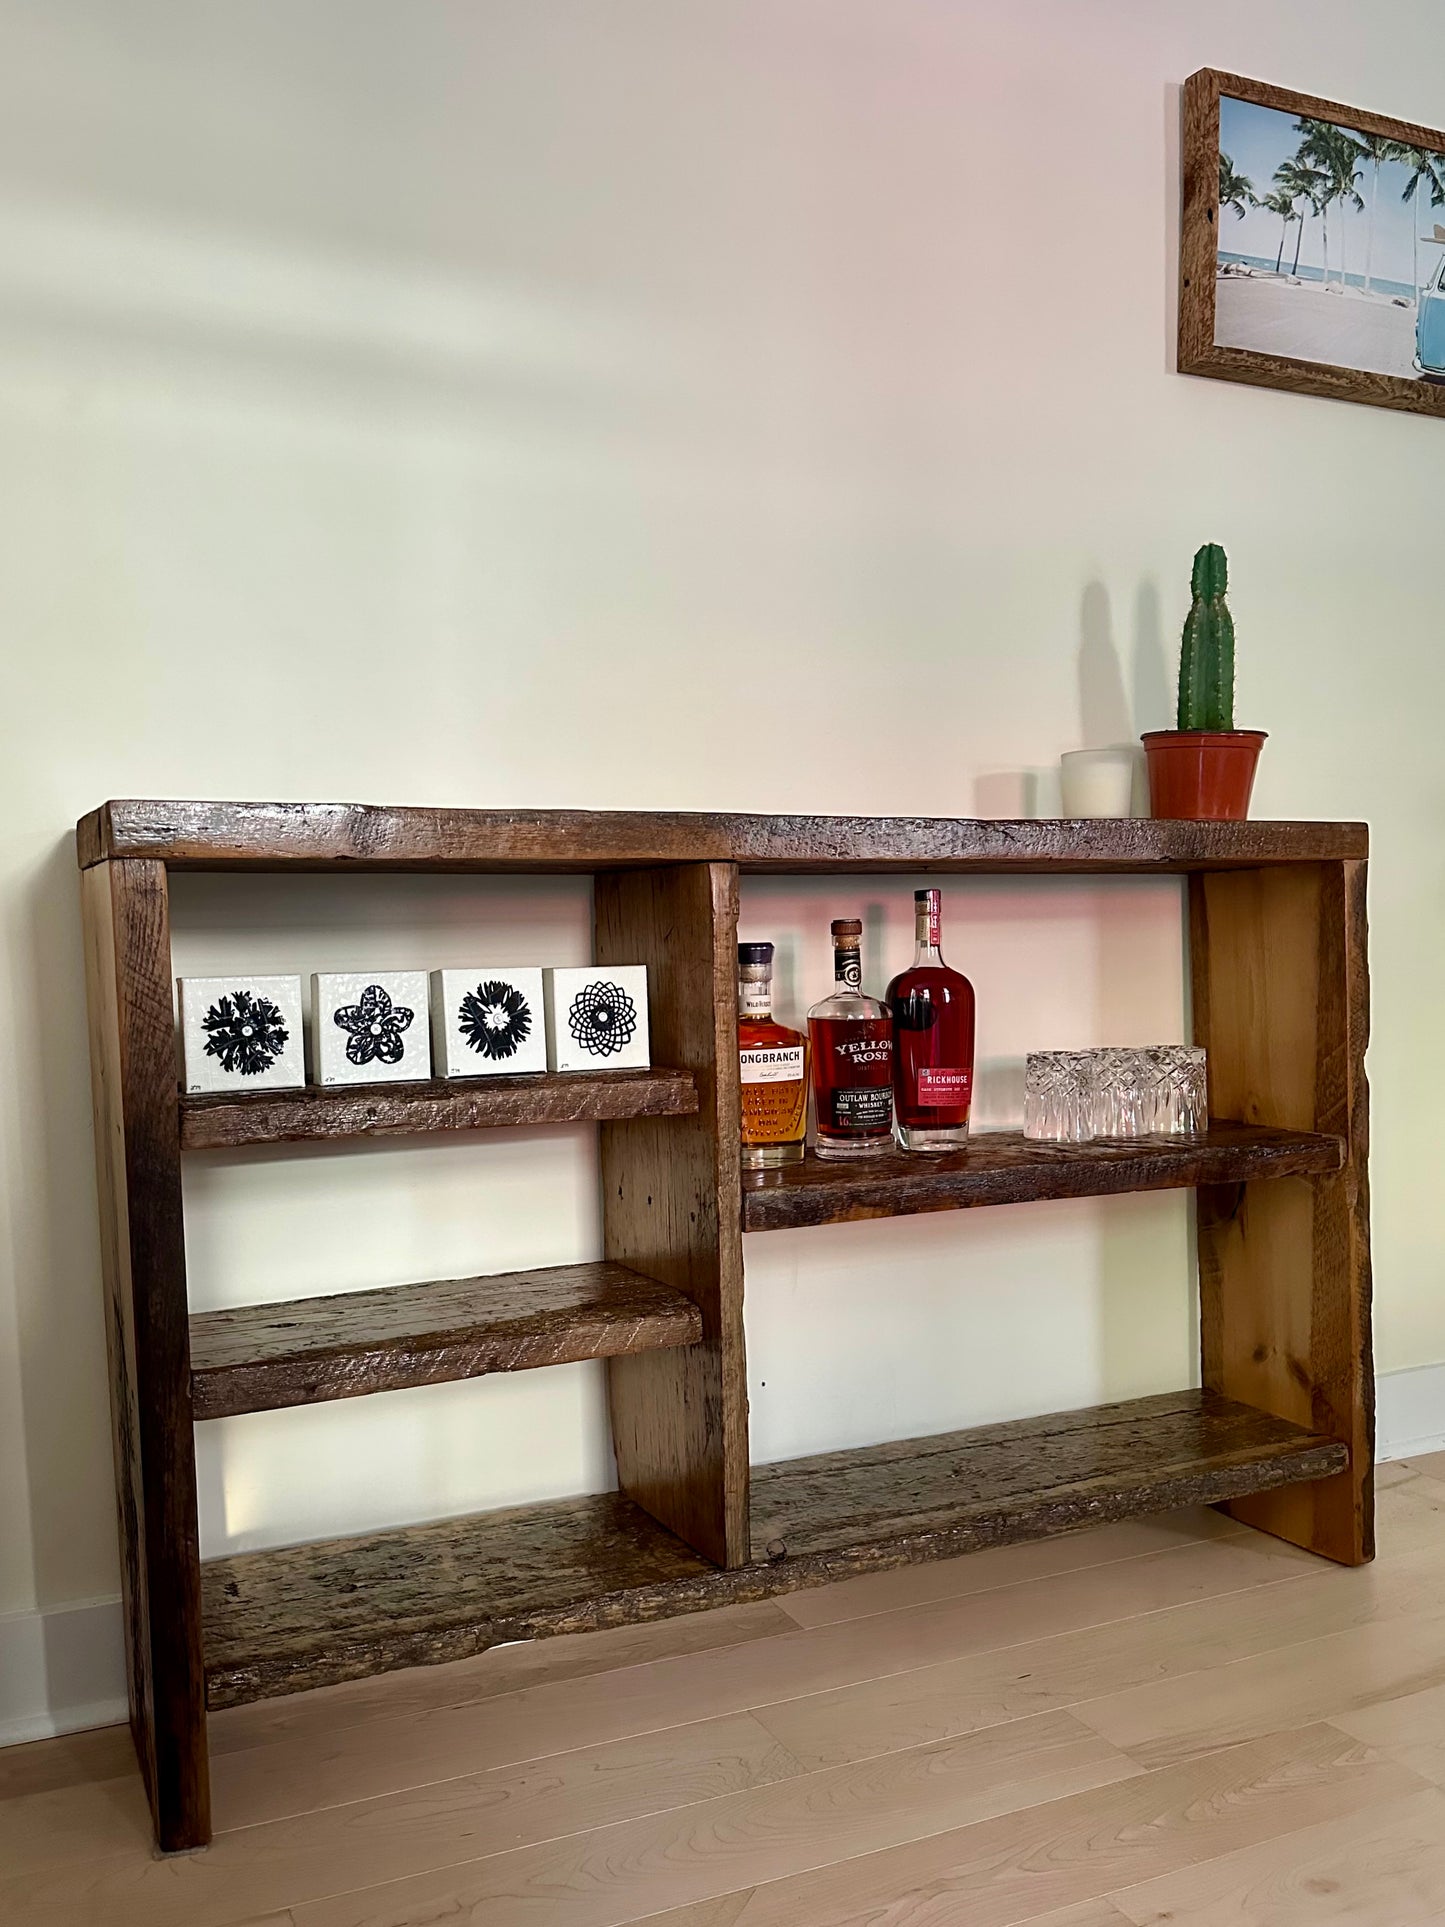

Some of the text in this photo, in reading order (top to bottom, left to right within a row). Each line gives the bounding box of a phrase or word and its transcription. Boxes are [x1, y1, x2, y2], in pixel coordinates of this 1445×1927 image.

[741, 1050, 800, 1065] ONGBRANCH
[852, 1051, 888, 1063] ROSE
[927, 1075, 967, 1084] RICKHOUSE
[839, 1094, 868, 1102] OUTLAW
[858, 1101, 883, 1109] WHISKEY
